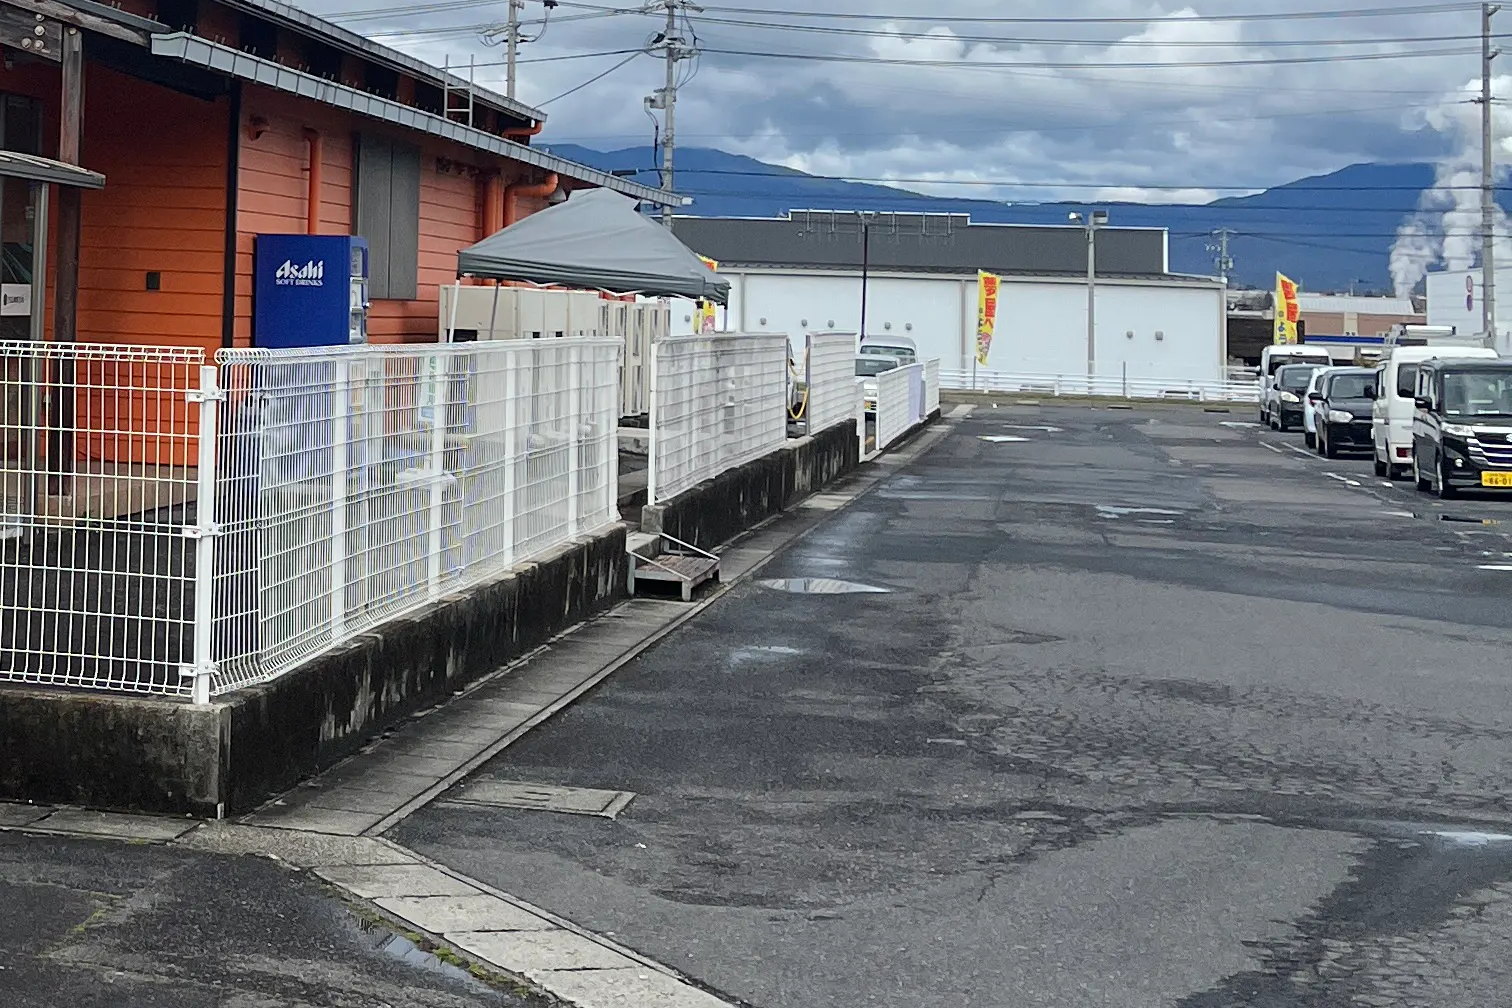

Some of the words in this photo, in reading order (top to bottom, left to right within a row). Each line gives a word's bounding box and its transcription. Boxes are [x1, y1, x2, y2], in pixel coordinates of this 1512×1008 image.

[275, 259, 324, 279] Asahi
[275, 278, 295, 286] SOFT
[295, 279, 324, 287] DRINKS
